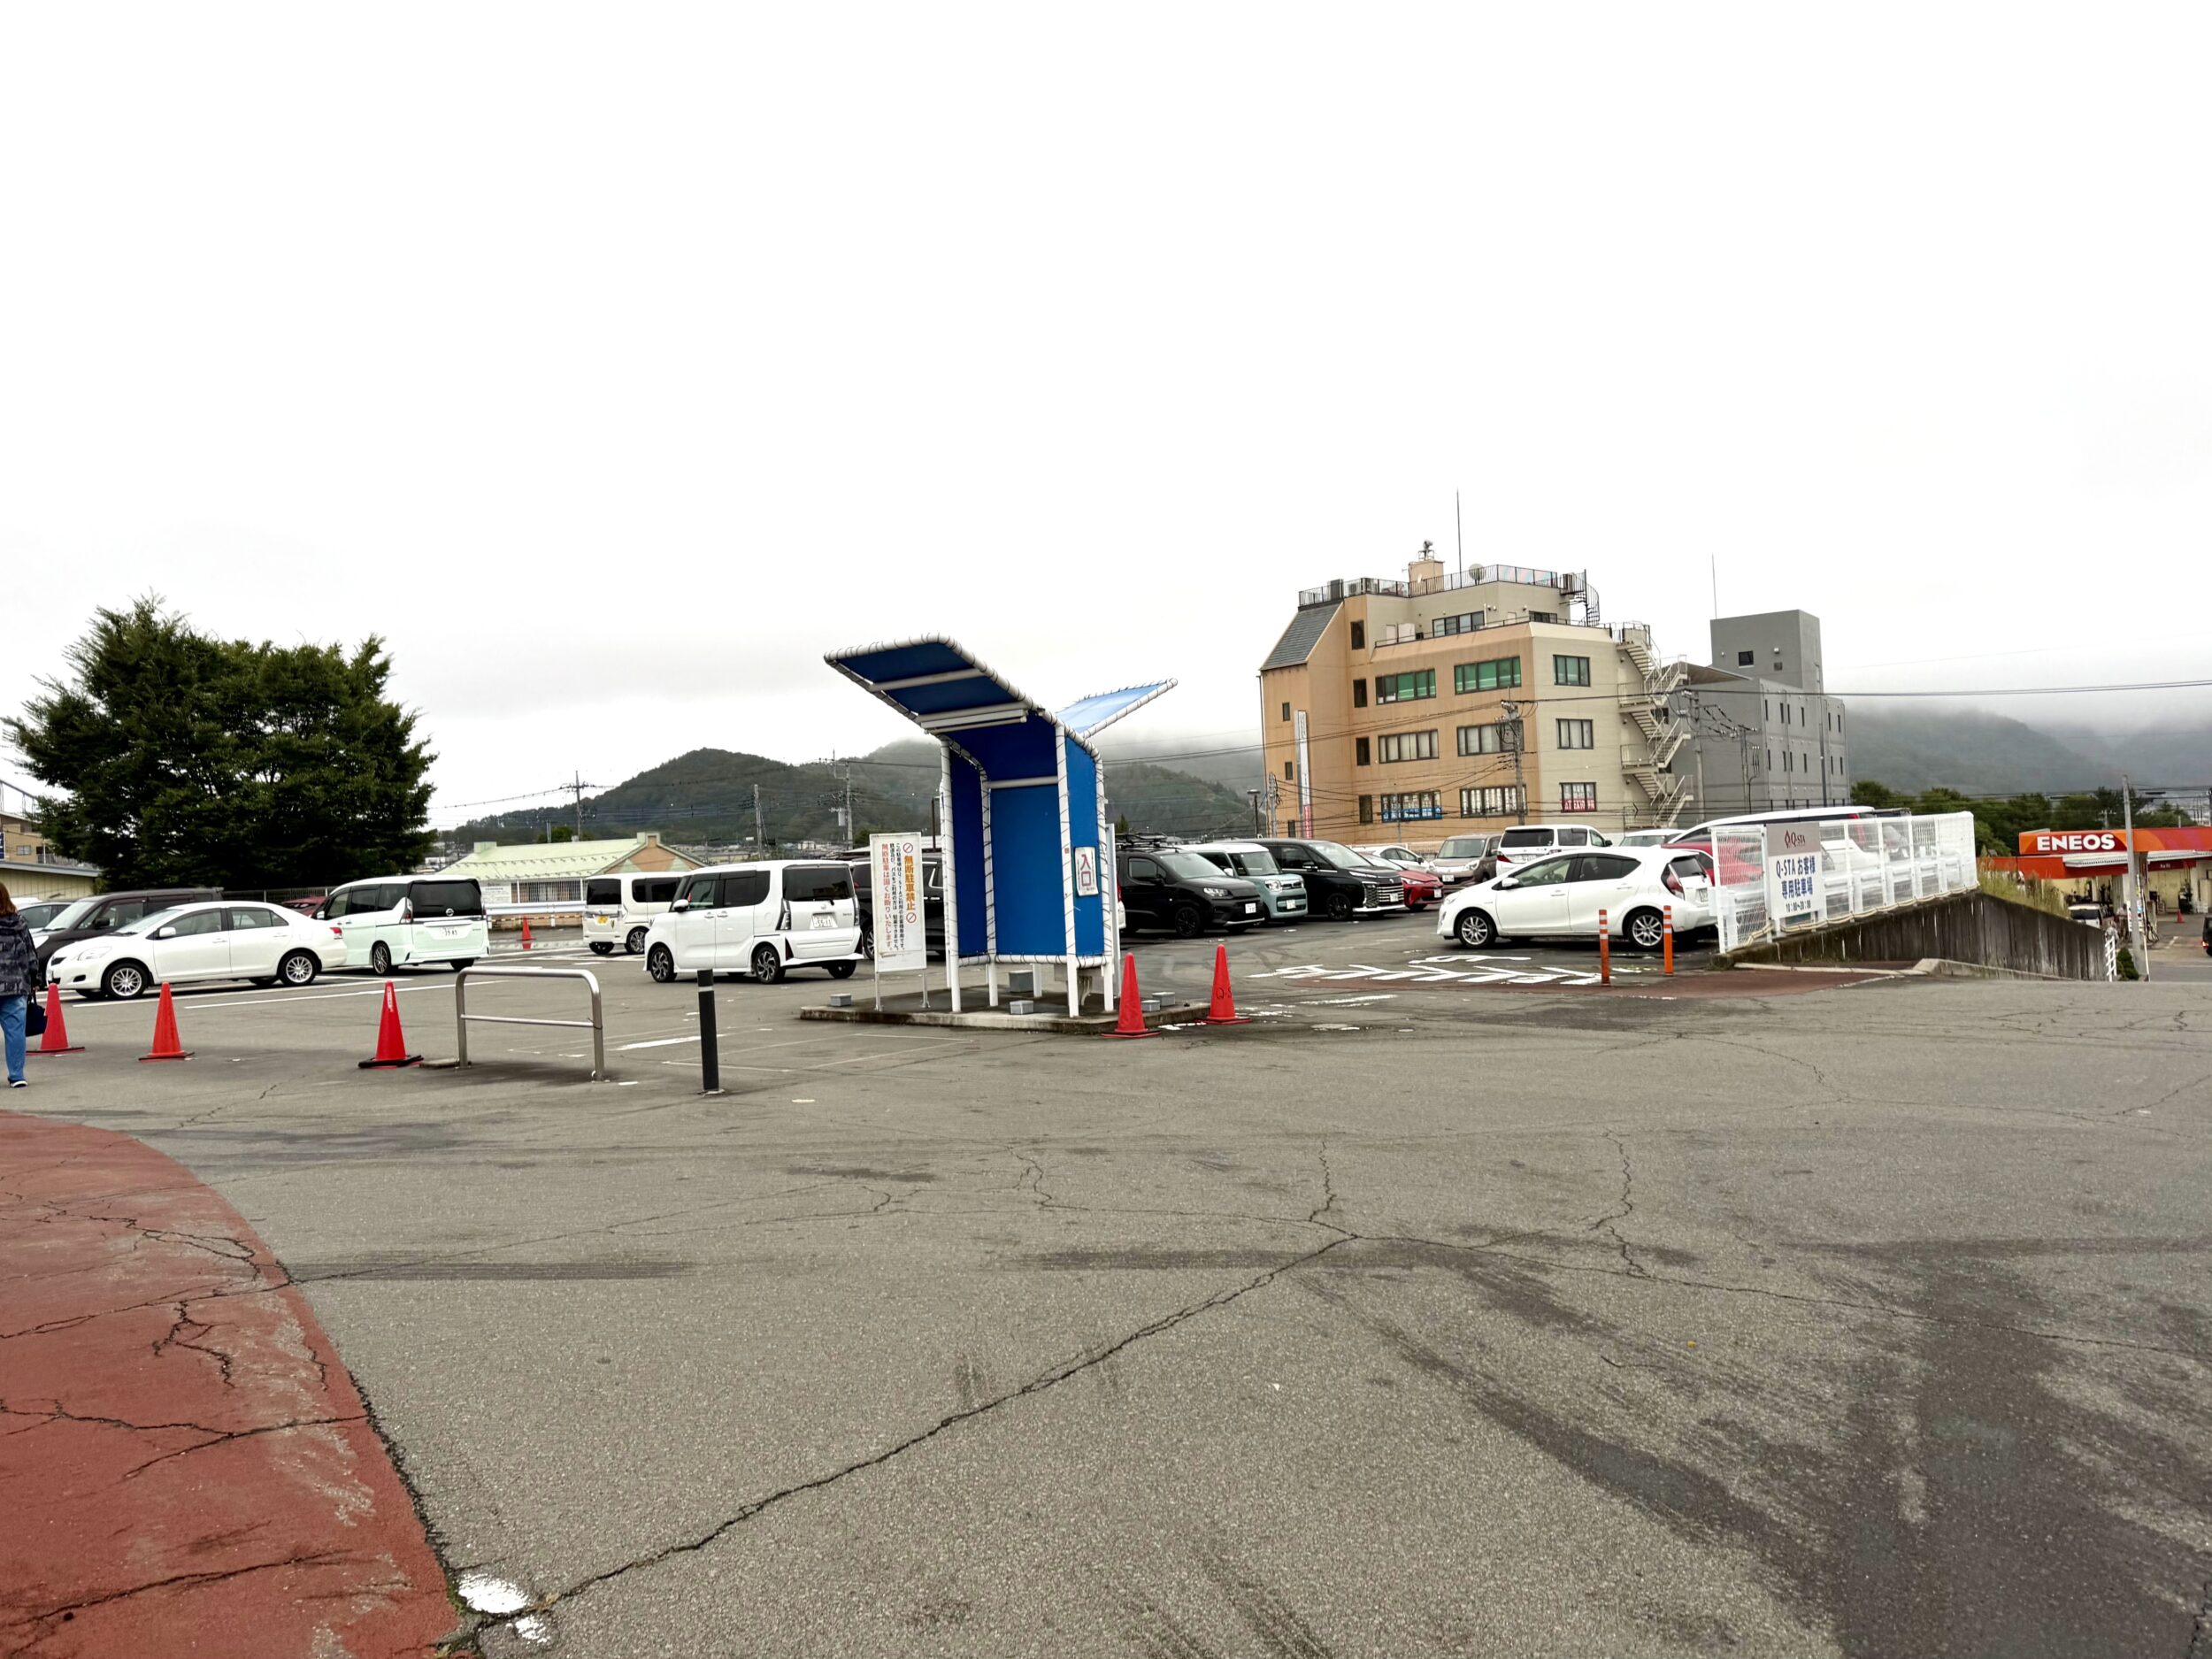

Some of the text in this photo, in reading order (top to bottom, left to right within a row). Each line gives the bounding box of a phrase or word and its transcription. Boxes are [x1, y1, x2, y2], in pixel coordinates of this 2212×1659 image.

[2037, 833, 2116, 851] ENEOS
[904, 856, 916, 910] 無断駐車禁止
[1080, 854, 1091, 886] 入口
[1781, 877, 1813, 899] 専用駐車場
